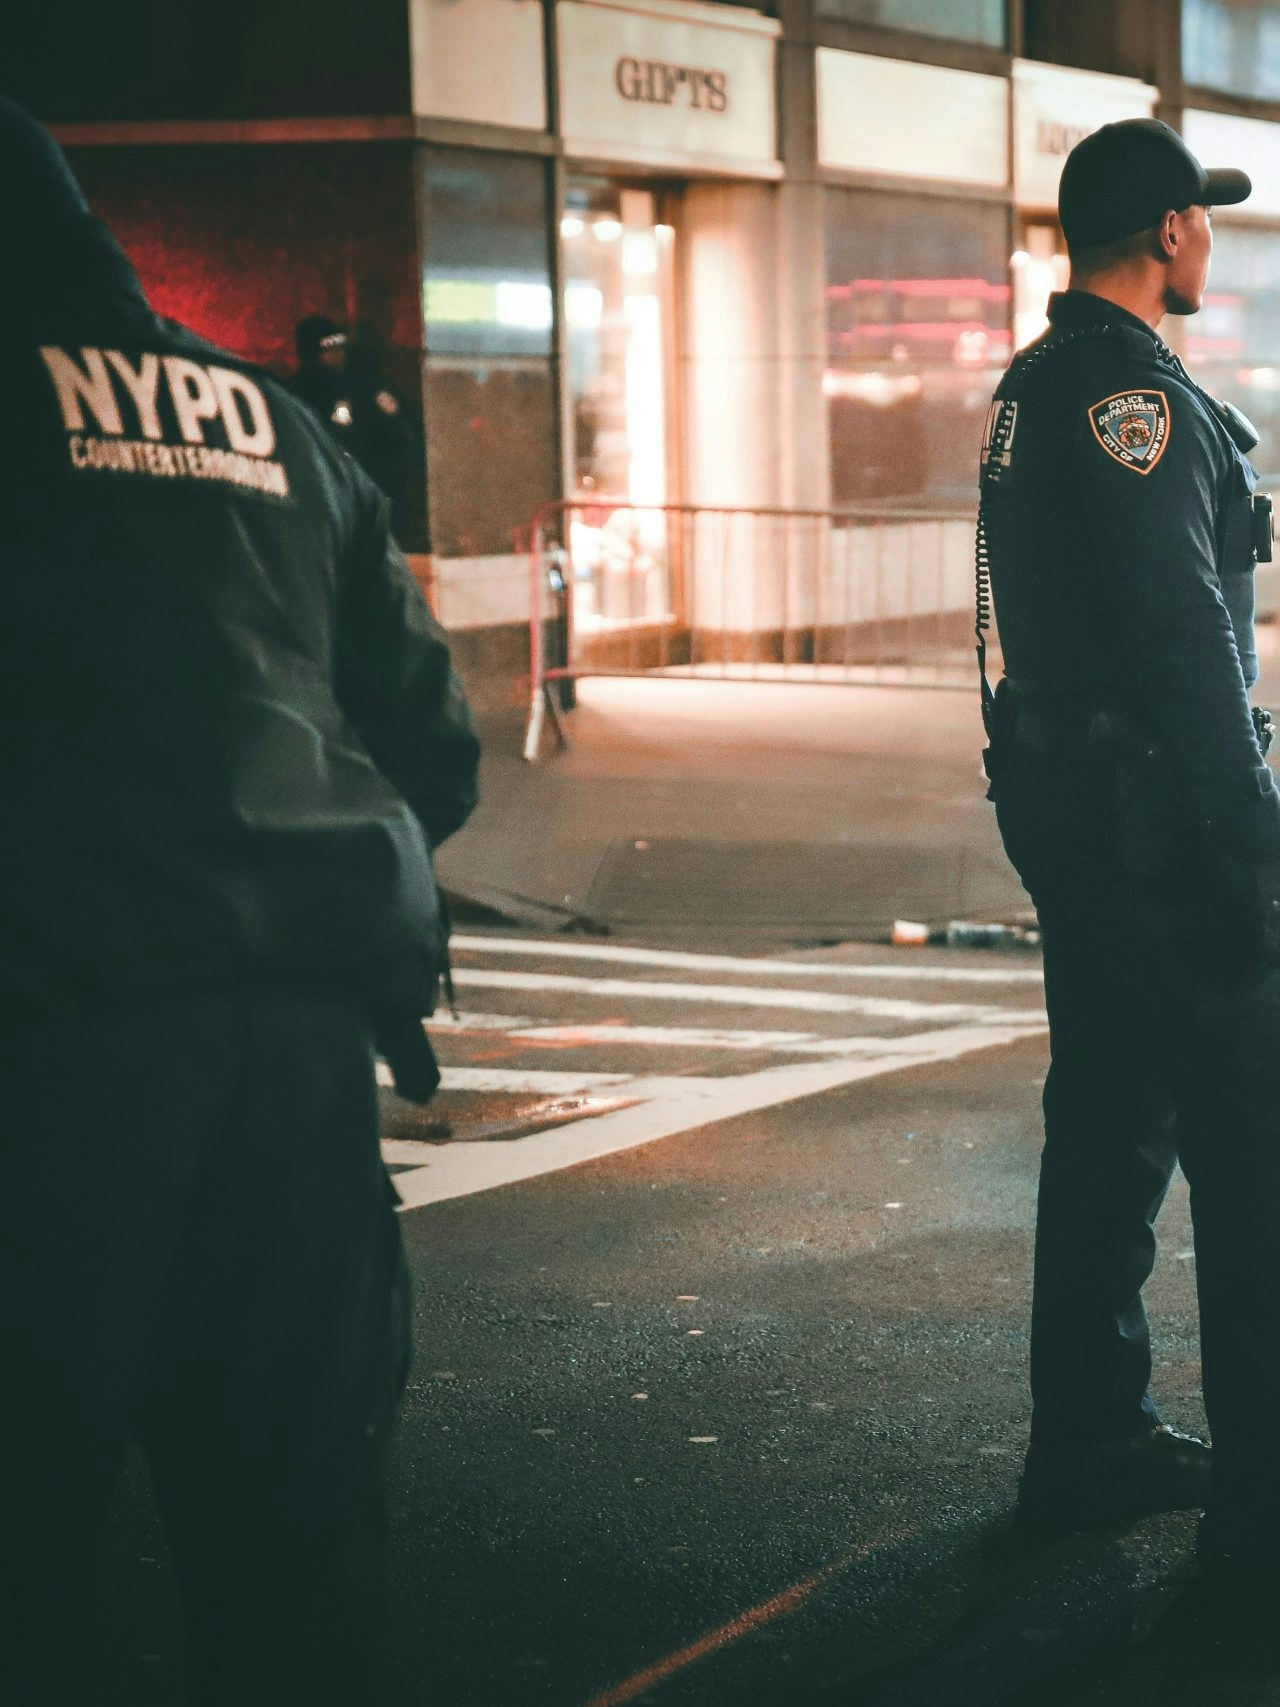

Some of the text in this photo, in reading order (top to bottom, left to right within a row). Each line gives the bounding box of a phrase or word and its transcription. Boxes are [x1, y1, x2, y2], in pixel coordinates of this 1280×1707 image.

[615, 56, 728, 113] GIFTS
[40, 345, 276, 458] NYPD
[1098, 402, 1160, 426] DEPARTMENT
[1108, 395, 1145, 411] POLICE
[1102, 433, 1134, 462] CITY OF
[1146, 417, 1165, 461] NEW YORK
